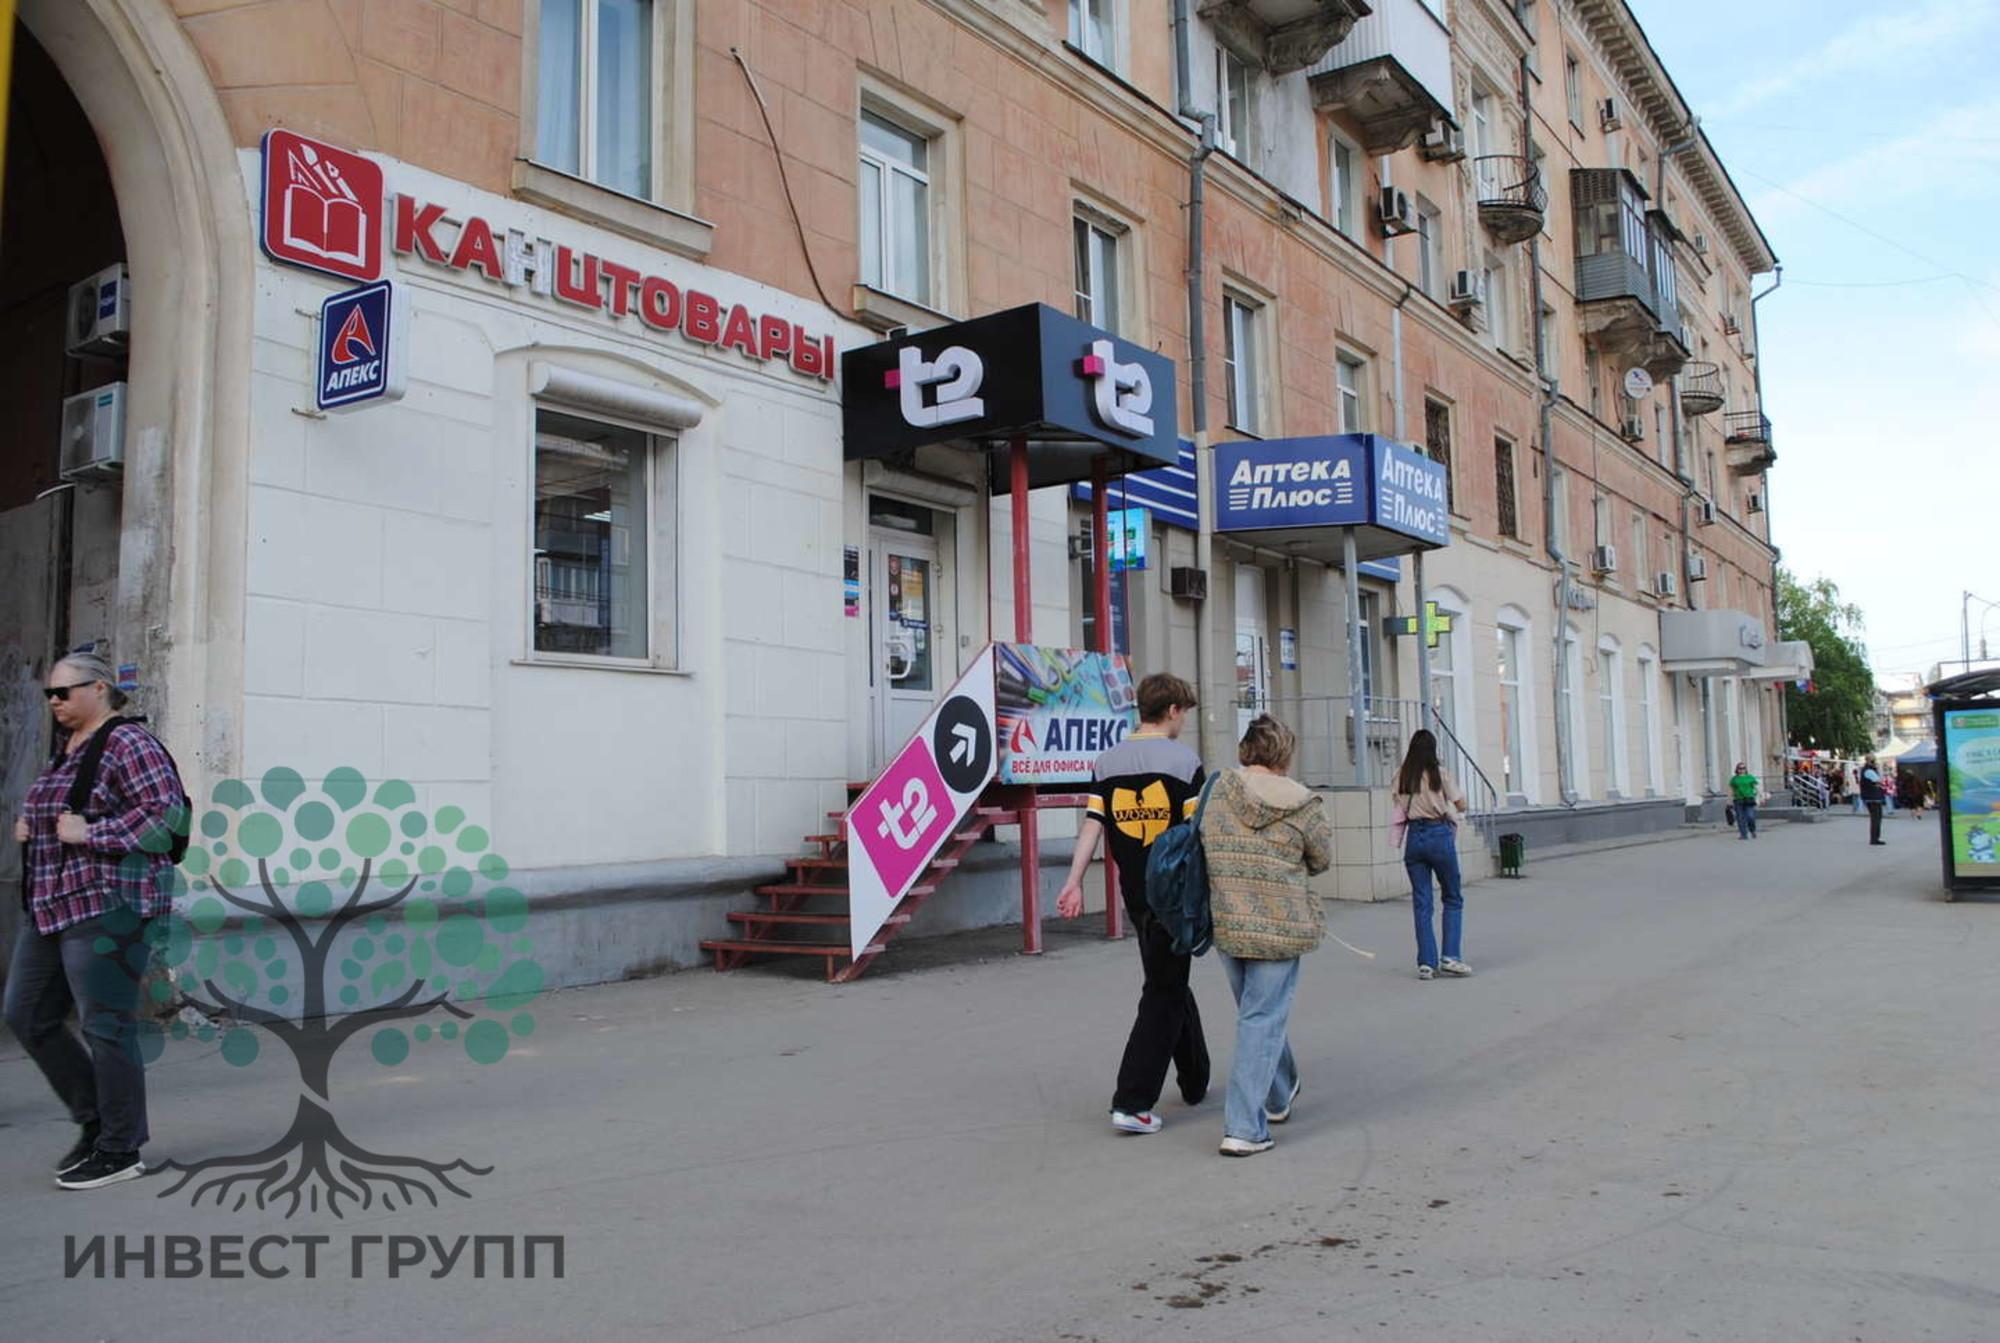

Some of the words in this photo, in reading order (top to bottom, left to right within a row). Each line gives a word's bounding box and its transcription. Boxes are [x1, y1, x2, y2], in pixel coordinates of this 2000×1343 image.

[392, 192, 835, 382] КАНЦТОВАРЫ
[325, 360, 380, 393] АПЕКС
[1251, 486, 1332, 509] Плюс
[1395, 494, 1435, 534] Плюс
[1043, 717, 1128, 752] АПЕКС
[1011, 757, 1031, 774] ВСЁ
[1032, 760, 1051, 775] ДЛЯ
[1053, 759, 1085, 773] ОФИСА
